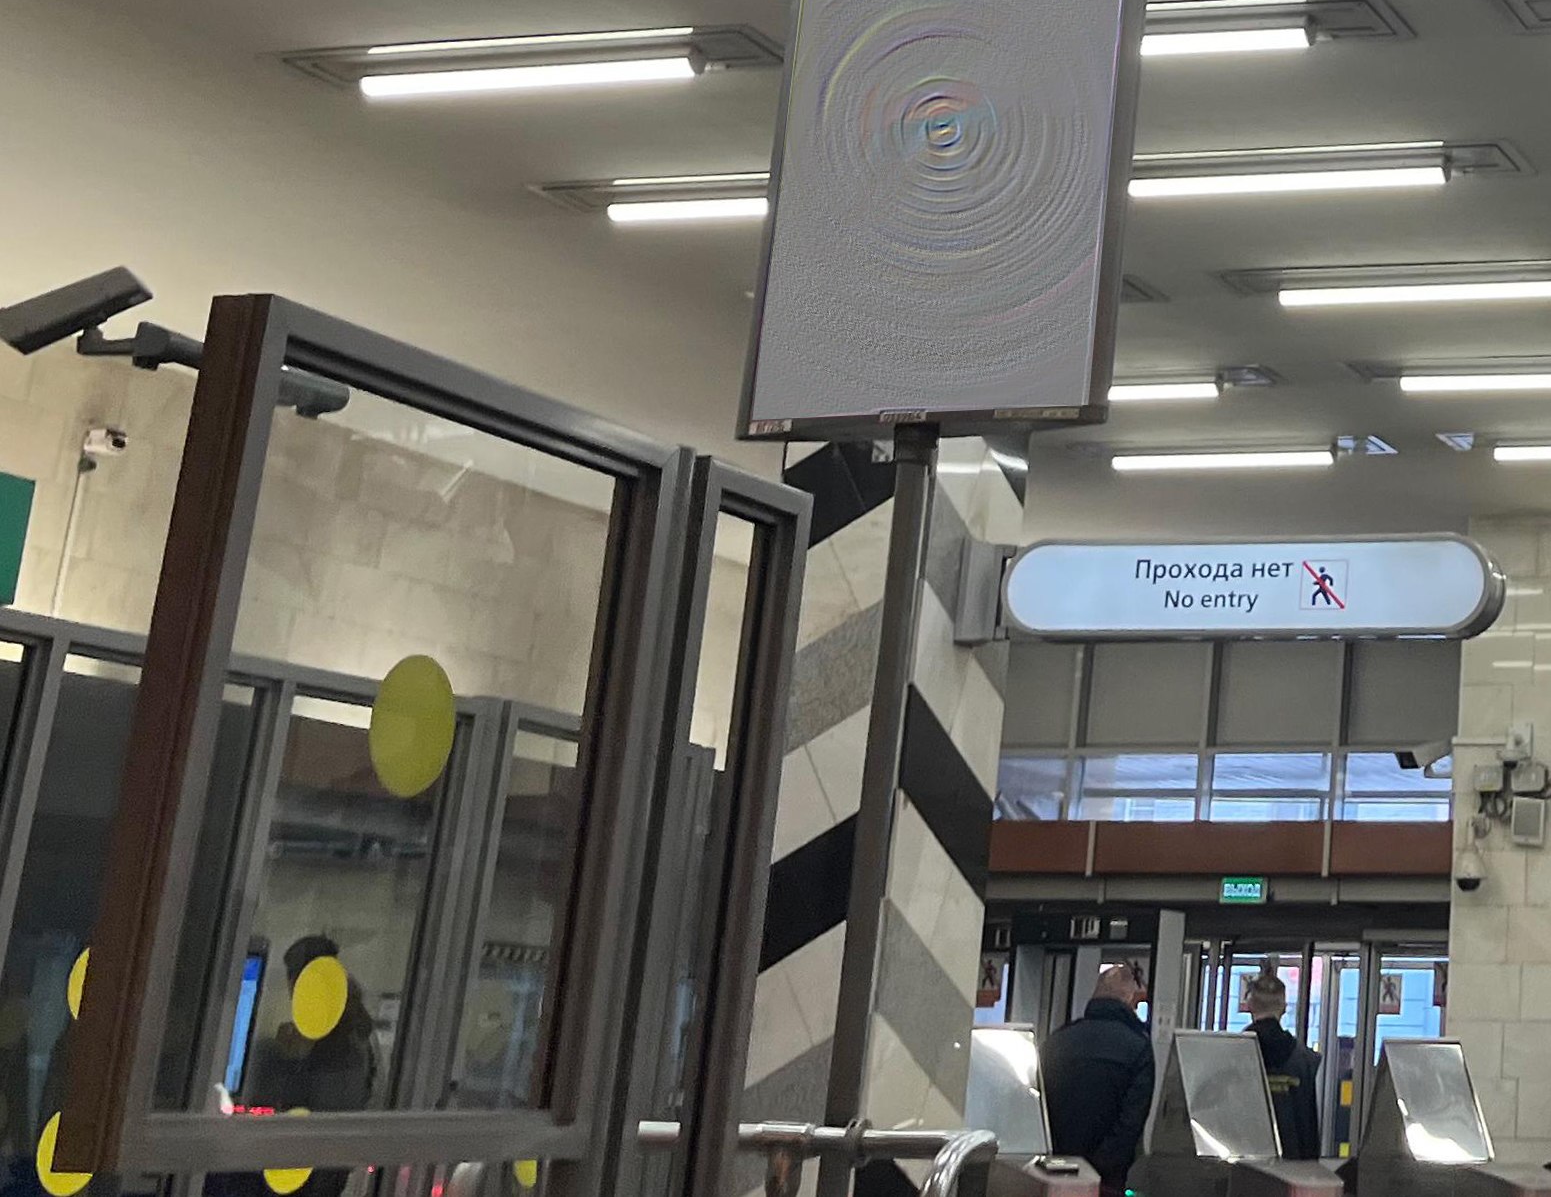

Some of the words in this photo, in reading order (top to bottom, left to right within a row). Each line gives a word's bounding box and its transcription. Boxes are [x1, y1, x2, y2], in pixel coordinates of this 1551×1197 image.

[1134, 559, 1244, 584] Прохода
[1251, 560, 1294, 579] нет
[1164, 590, 1193, 609] No
[1200, 591, 1259, 613] entry
